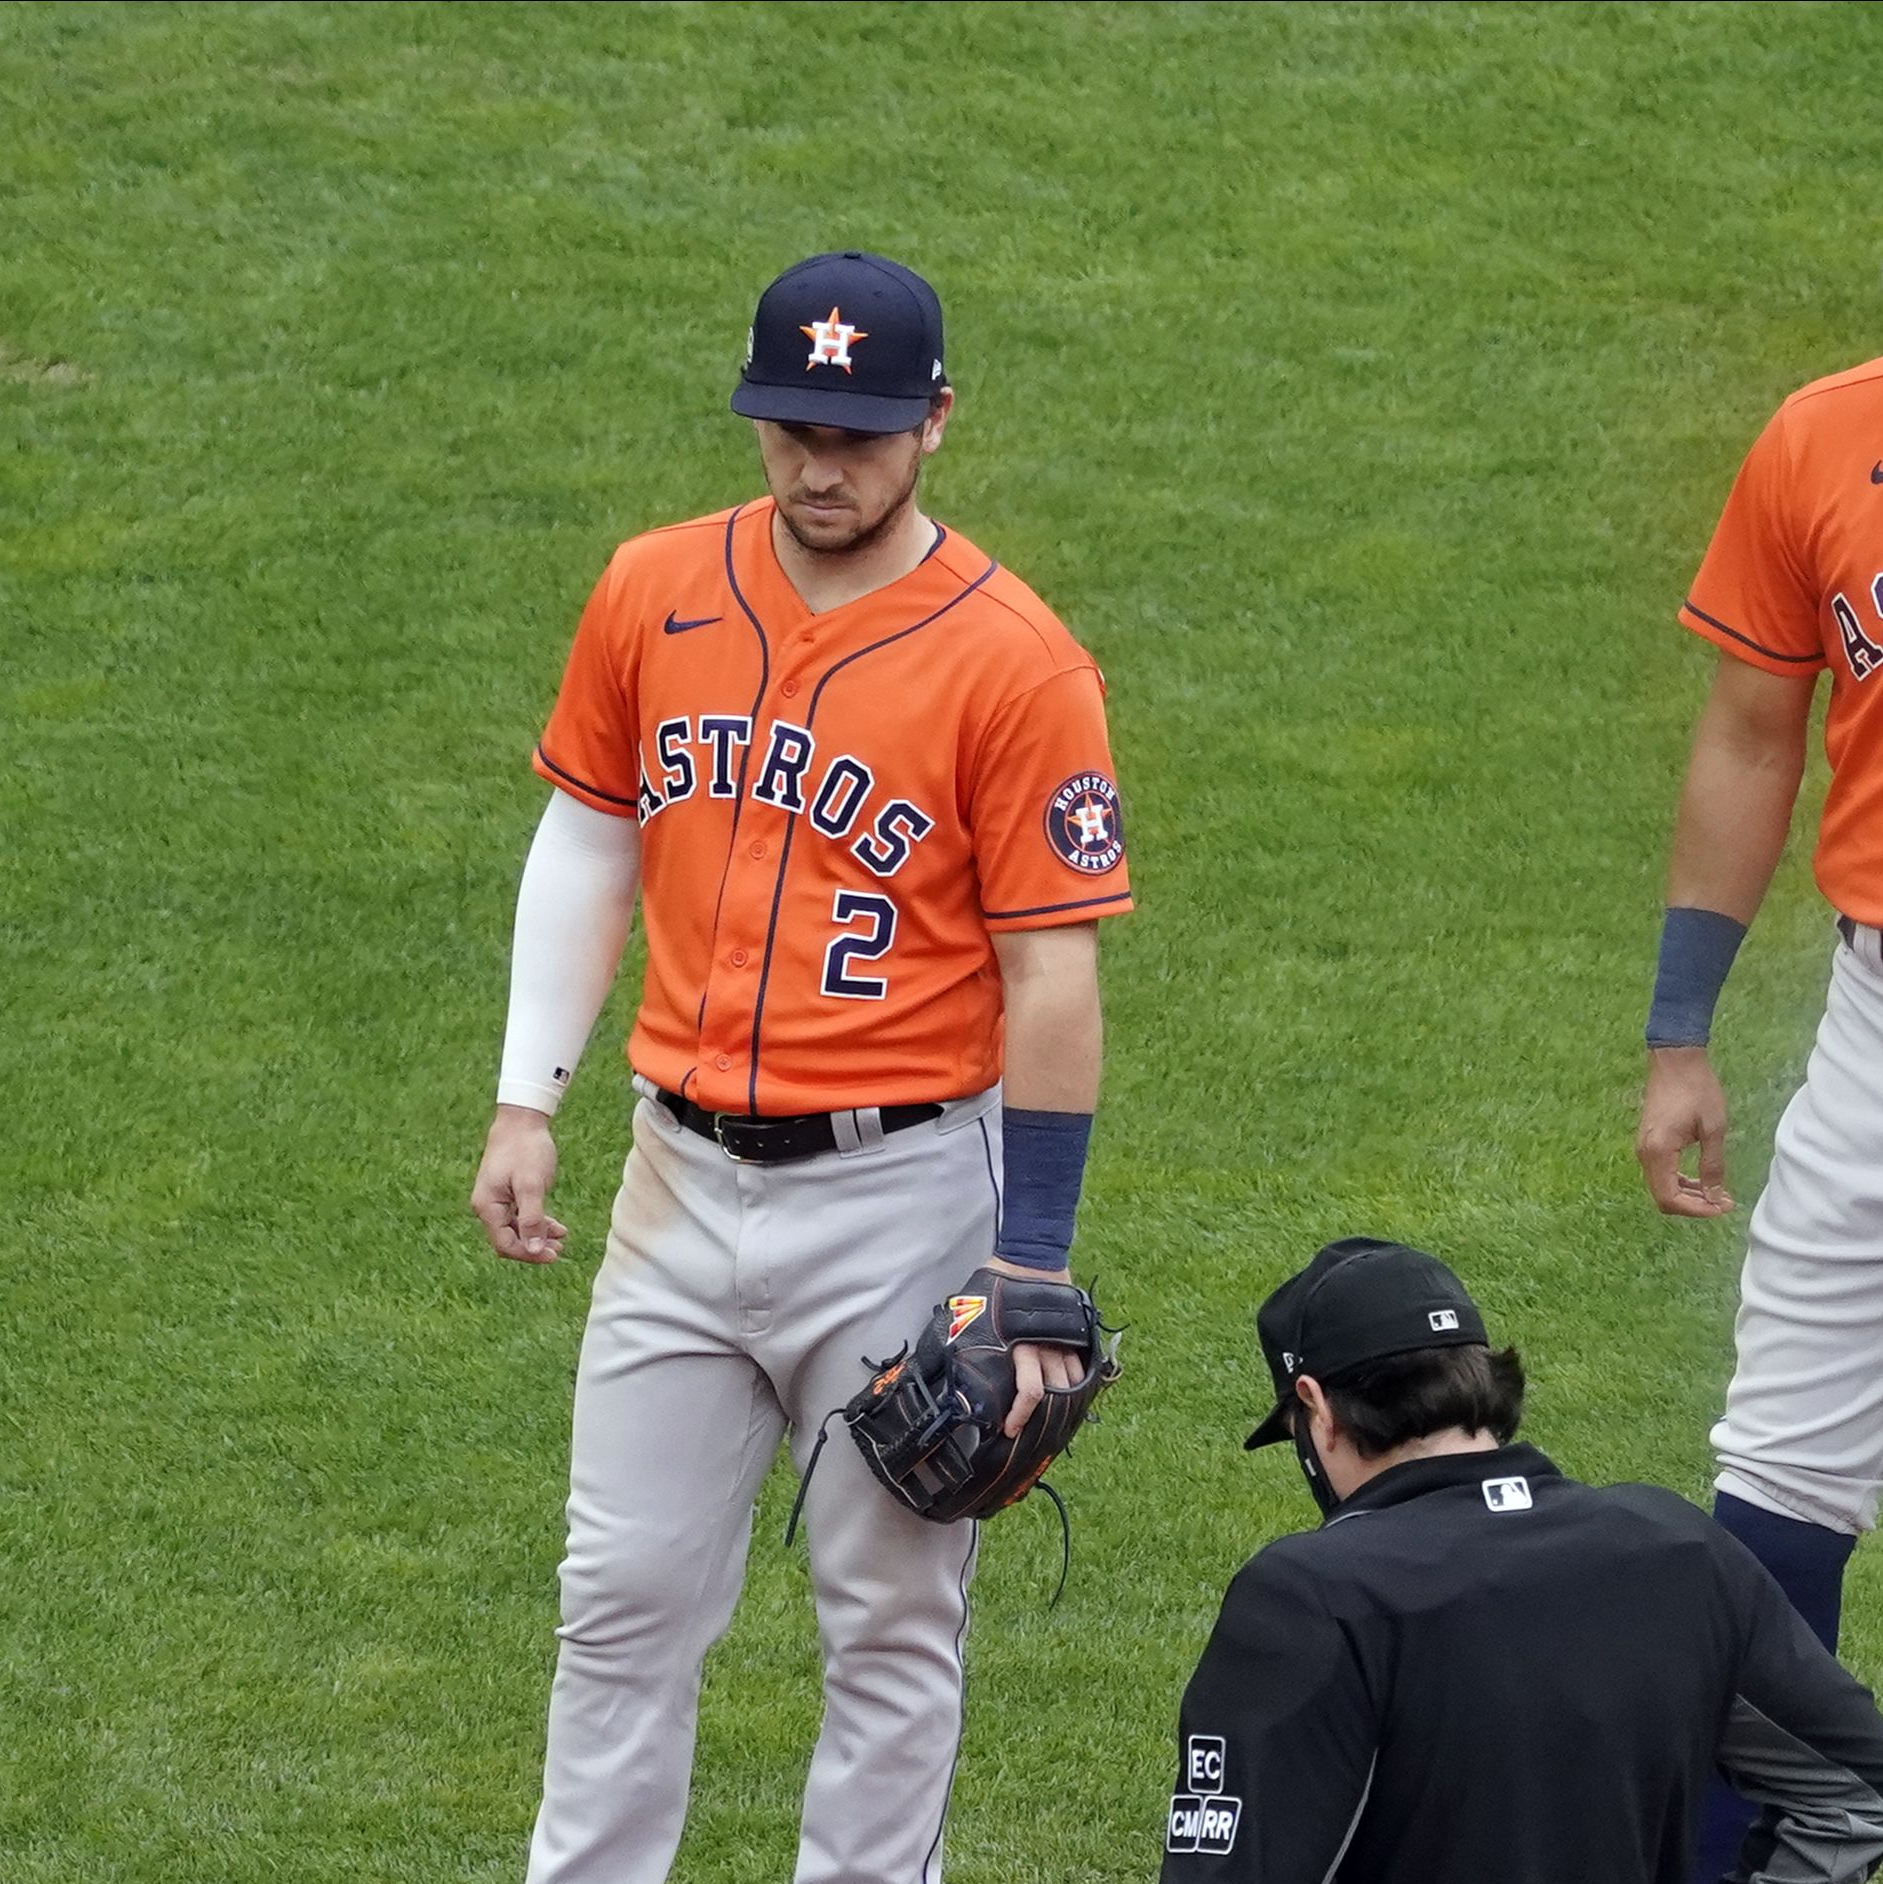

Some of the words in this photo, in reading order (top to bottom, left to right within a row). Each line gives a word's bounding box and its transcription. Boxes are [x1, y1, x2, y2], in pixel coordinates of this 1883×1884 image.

[1054, 776, 1115, 812] HOUSTON
[1068, 840, 1122, 869] ASTROS
[820, 889, 898, 1000] 2
[1191, 1749, 1221, 1779] EC
[1171, 1810, 1199, 1837] CM
[1201, 1809, 1234, 1840] RR
